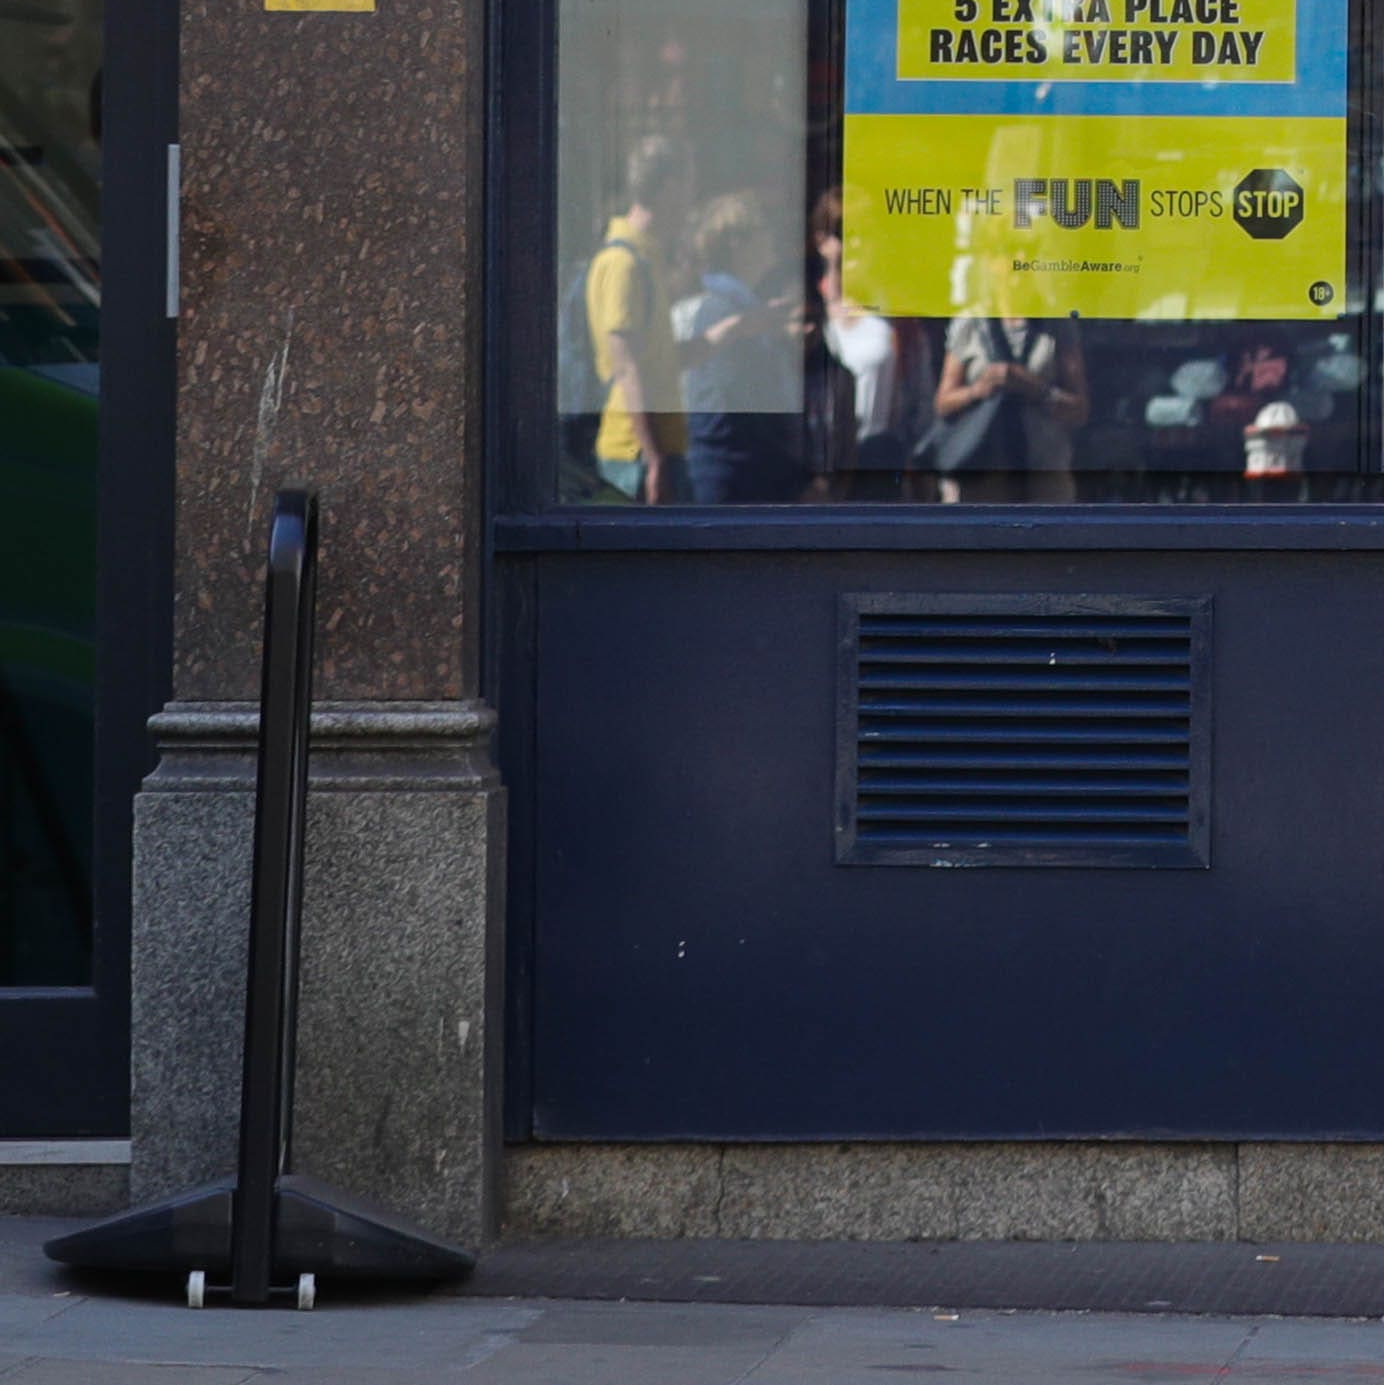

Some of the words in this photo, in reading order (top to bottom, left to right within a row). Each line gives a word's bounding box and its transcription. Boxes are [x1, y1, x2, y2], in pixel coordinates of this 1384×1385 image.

[930, 29, 1046, 65] RACES
[1063, 30, 1178, 65] EVERY
[1191, 31, 1264, 66] DAY
[885, 188, 951, 216] WHEN
[960, 188, 1002, 216] THE
[1013, 178, 1141, 230] FUN
[1150, 190, 1224, 217] STOPS
[1237, 190, 1300, 219] STOP
[1312, 287, 1331, 301] 18+
